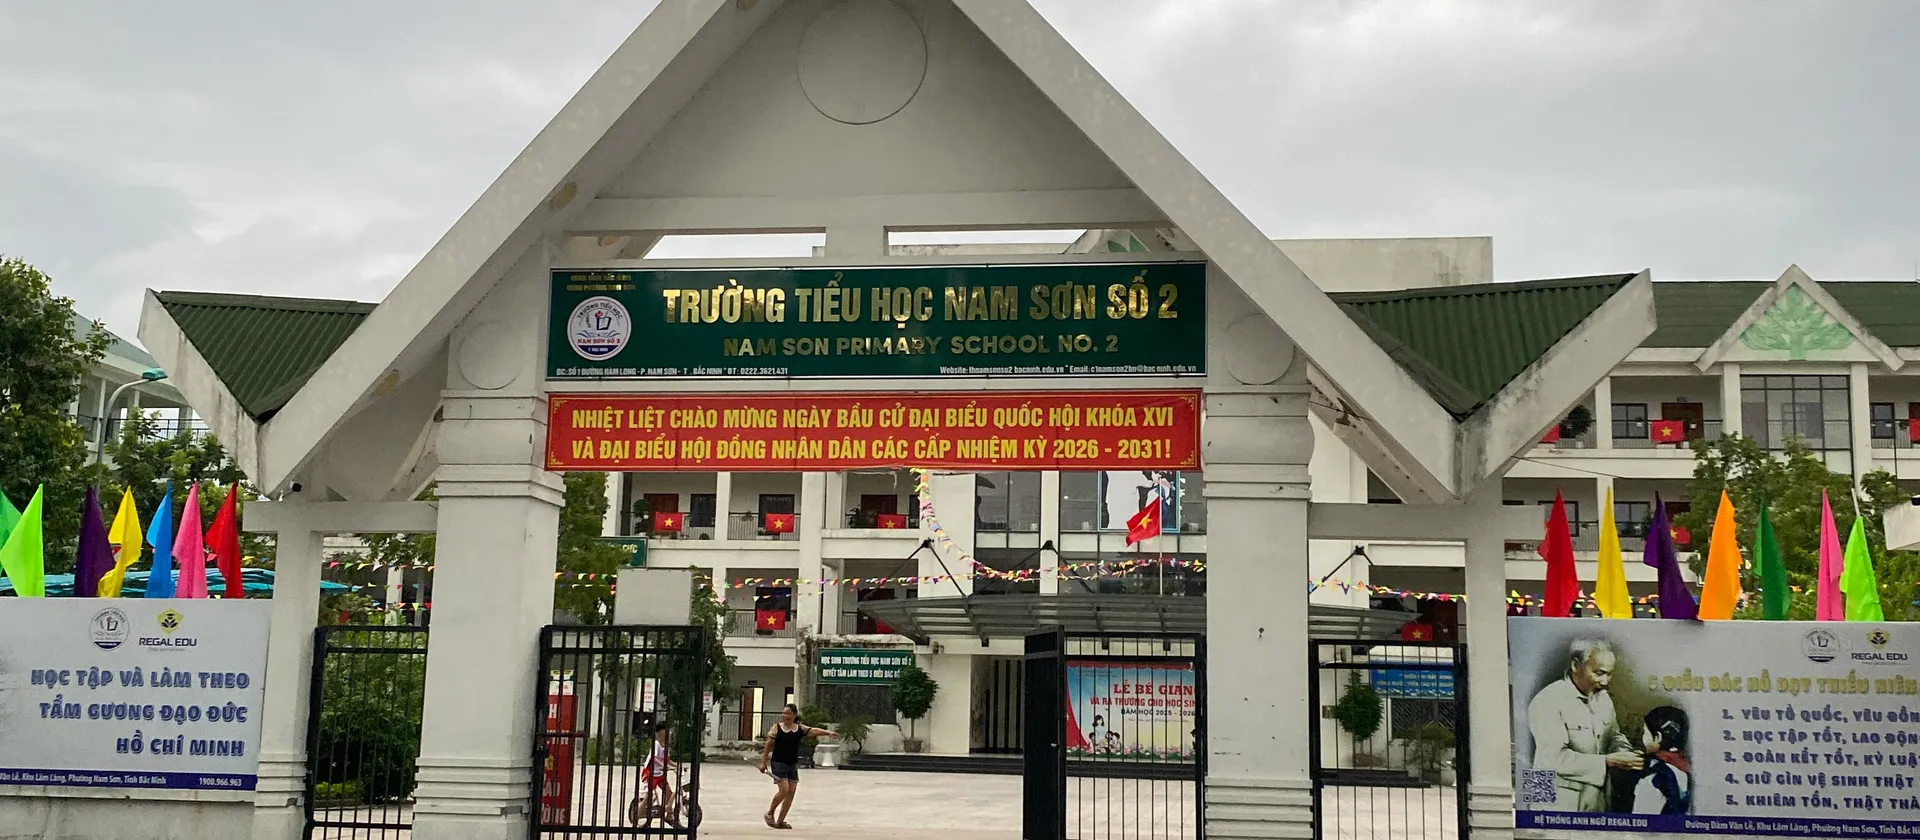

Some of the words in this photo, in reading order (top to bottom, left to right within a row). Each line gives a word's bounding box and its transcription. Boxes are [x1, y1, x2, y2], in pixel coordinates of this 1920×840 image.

[663, 278, 785, 323] TRƯỜNG
[795, 272, 861, 322] TIỂU
[871, 286, 933, 329] HỌC
[944, 286, 1018, 321] NAM
[1029, 281, 1096, 321] SƠN
[1106, 270, 1149, 319] SỐ
[1158, 284, 1178, 319] 2
[724, 339, 777, 356] NAM
[783, 338, 828, 356] SON
[836, 336, 942, 356] PRIMARY
[951, 335, 1050, 354] SCHOOL
[1058, 334, 1098, 353] NO.
[1106, 334, 1119, 353] 2
[572, 406, 624, 432] NHIỆT
[628, 406, 665, 432] LIỆT
[670, 406, 717, 429] CHÀO
[723, 406, 777, 428] MỪNG
[782, 405, 832, 428] NGÀY
[837, 402, 874, 428] BẦU
[879, 402, 905, 427] CỬ
[908, 409, 940, 432] ĐẠI
[946, 400, 988, 427] BIỂU
[993, 401, 1043, 429] QUỐC
[1049, 405, 1080, 431] HỘI
[1086, 403, 1137, 427] KHÓA
[1142, 407, 1174, 427] XVI
[571, 436, 595, 460] VÀ
[599, 439, 630, 463] ĐẠI
[634, 433, 676, 460] BIỂU
[681, 436, 711, 463] HỘI
[716, 434, 765, 460] ĐỒNG
[771, 436, 823, 459] NHÂN
[828, 436, 866, 459] DÂN
[871, 435, 908, 459] CÁC
[914, 431, 951, 459] CẤP
[957, 435, 1017, 463] NHIỆM
[1023, 435, 1048, 459] KỲ
[1053, 439, 1099, 459] 2026
[1117, 439, 1171, 459] 2031!
[139, 637, 173, 646] REGAL
[175, 638, 197, 646] EDU
[1886, 653, 1908, 661] EDU
[30, 669, 70, 690] HỌC
[76, 666, 113, 690] TẬP
[119, 666, 144, 687] VÀ
[150, 667, 192, 688] LÀM
[198, 671, 250, 689] THEO
[39, 694, 82, 719] TẤM
[87, 702, 154, 721] GƯƠNG
[159, 704, 201, 725] ĐẠO
[205, 701, 248, 723] ĐỨC
[1741, 706, 1771, 720] YÊU
[1853, 708, 1882, 722] YÊU
[116, 729, 144, 755] HỒ
[150, 734, 183, 756] CHÍ
[189, 739, 245, 757] MINH
[1742, 730, 1773, 744] HỌC
[1778, 728, 1808, 744] TẬP
[1852, 732, 1881, 744] LAO
[1884, 730, 1920, 747] ĐỘN
[1742, 749, 1786, 763] ĐOÀN
[1889, 752, 1920, 768] LUẬ
[1776, 770, 1802, 785] GÌN
[1807, 772, 1826, 789] VỆ
[1831, 775, 1869, 787] SINH
[1873, 773, 1914, 790] THẬT
[1746, 792, 1796, 807] KHIÊM
[1843, 794, 1883, 811] THẬT
[1534, 814, 1544, 826] HỆ
[1545, 814, 1571, 825] THỐNG
[1572, 816, 1588, 825] ANH
[1607, 818, 1631, 827] REGAL
[1632, 819, 1648, 827] EDU
[1842, 824, 1860, 833] Nam
